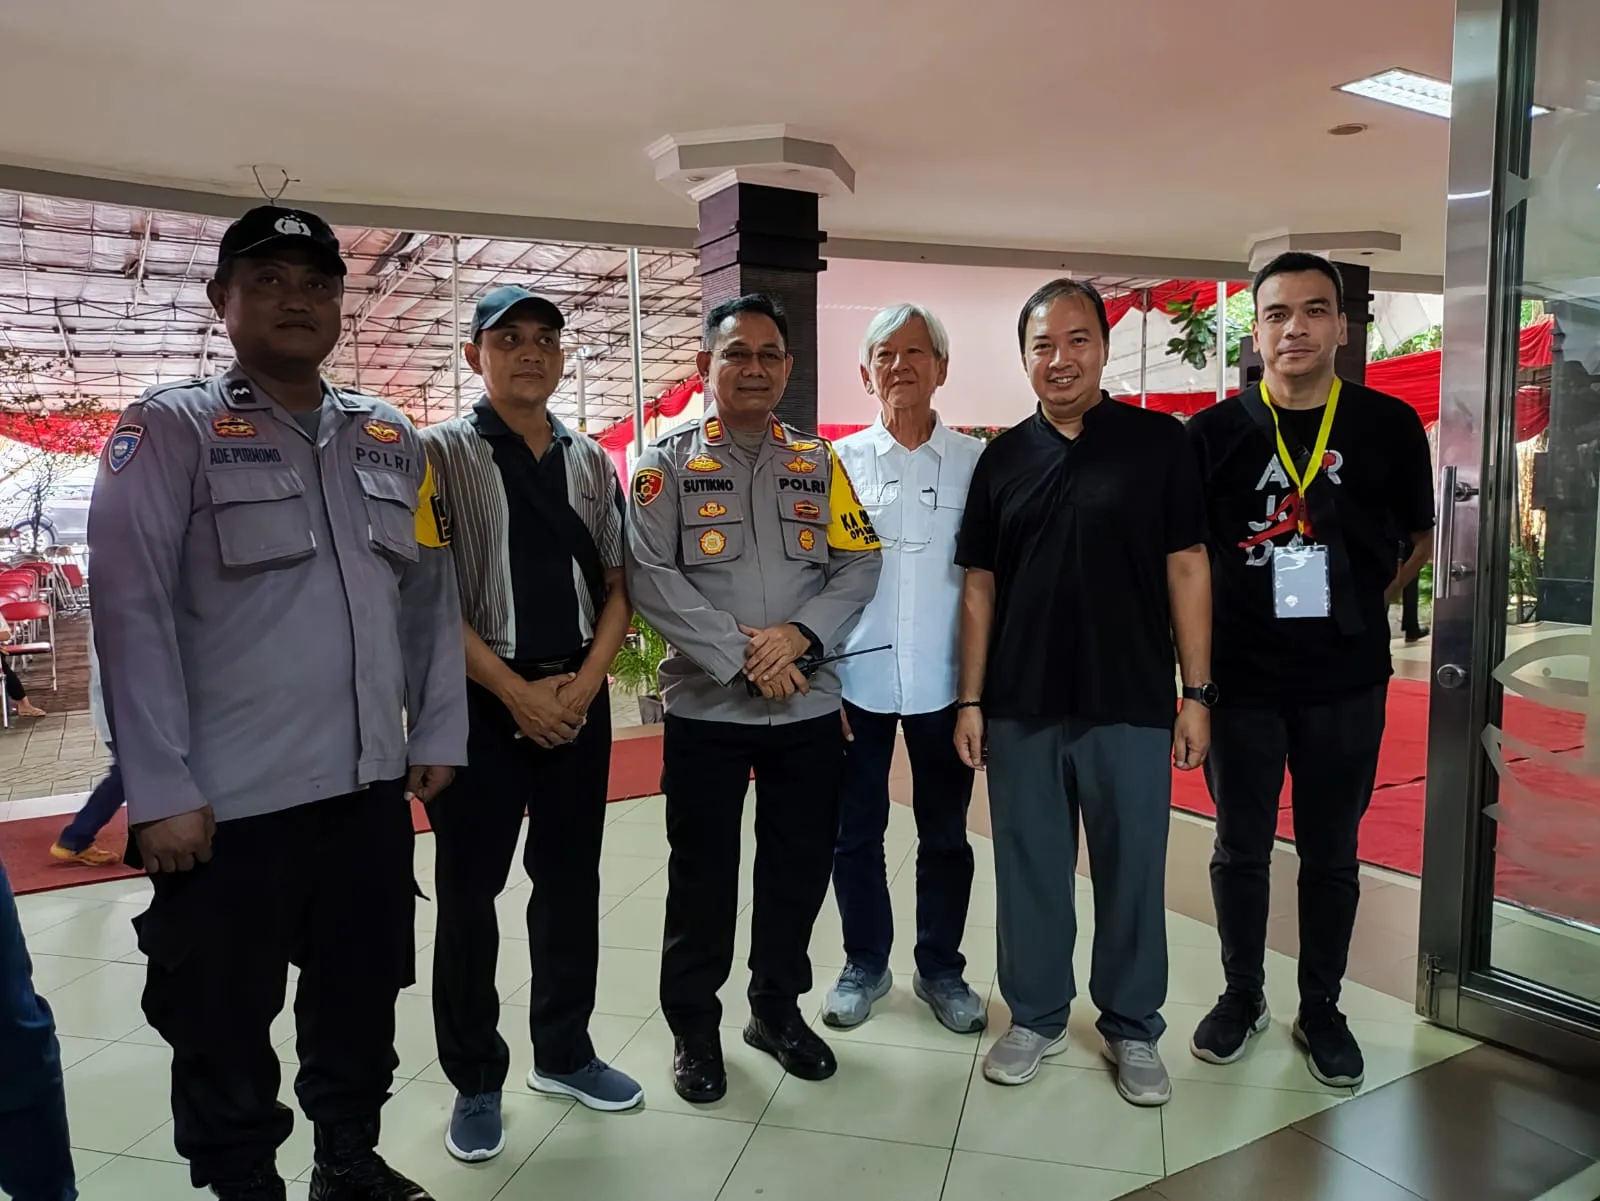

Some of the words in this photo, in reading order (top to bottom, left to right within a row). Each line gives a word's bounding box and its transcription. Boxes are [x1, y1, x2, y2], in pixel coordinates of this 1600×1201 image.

[210, 447, 232, 465] ADE
[356, 447, 411, 473] POLRI
[683, 479, 734, 493] SUTIKNO
[778, 477, 826, 494] POLRI
[840, 511, 859, 531] KA
